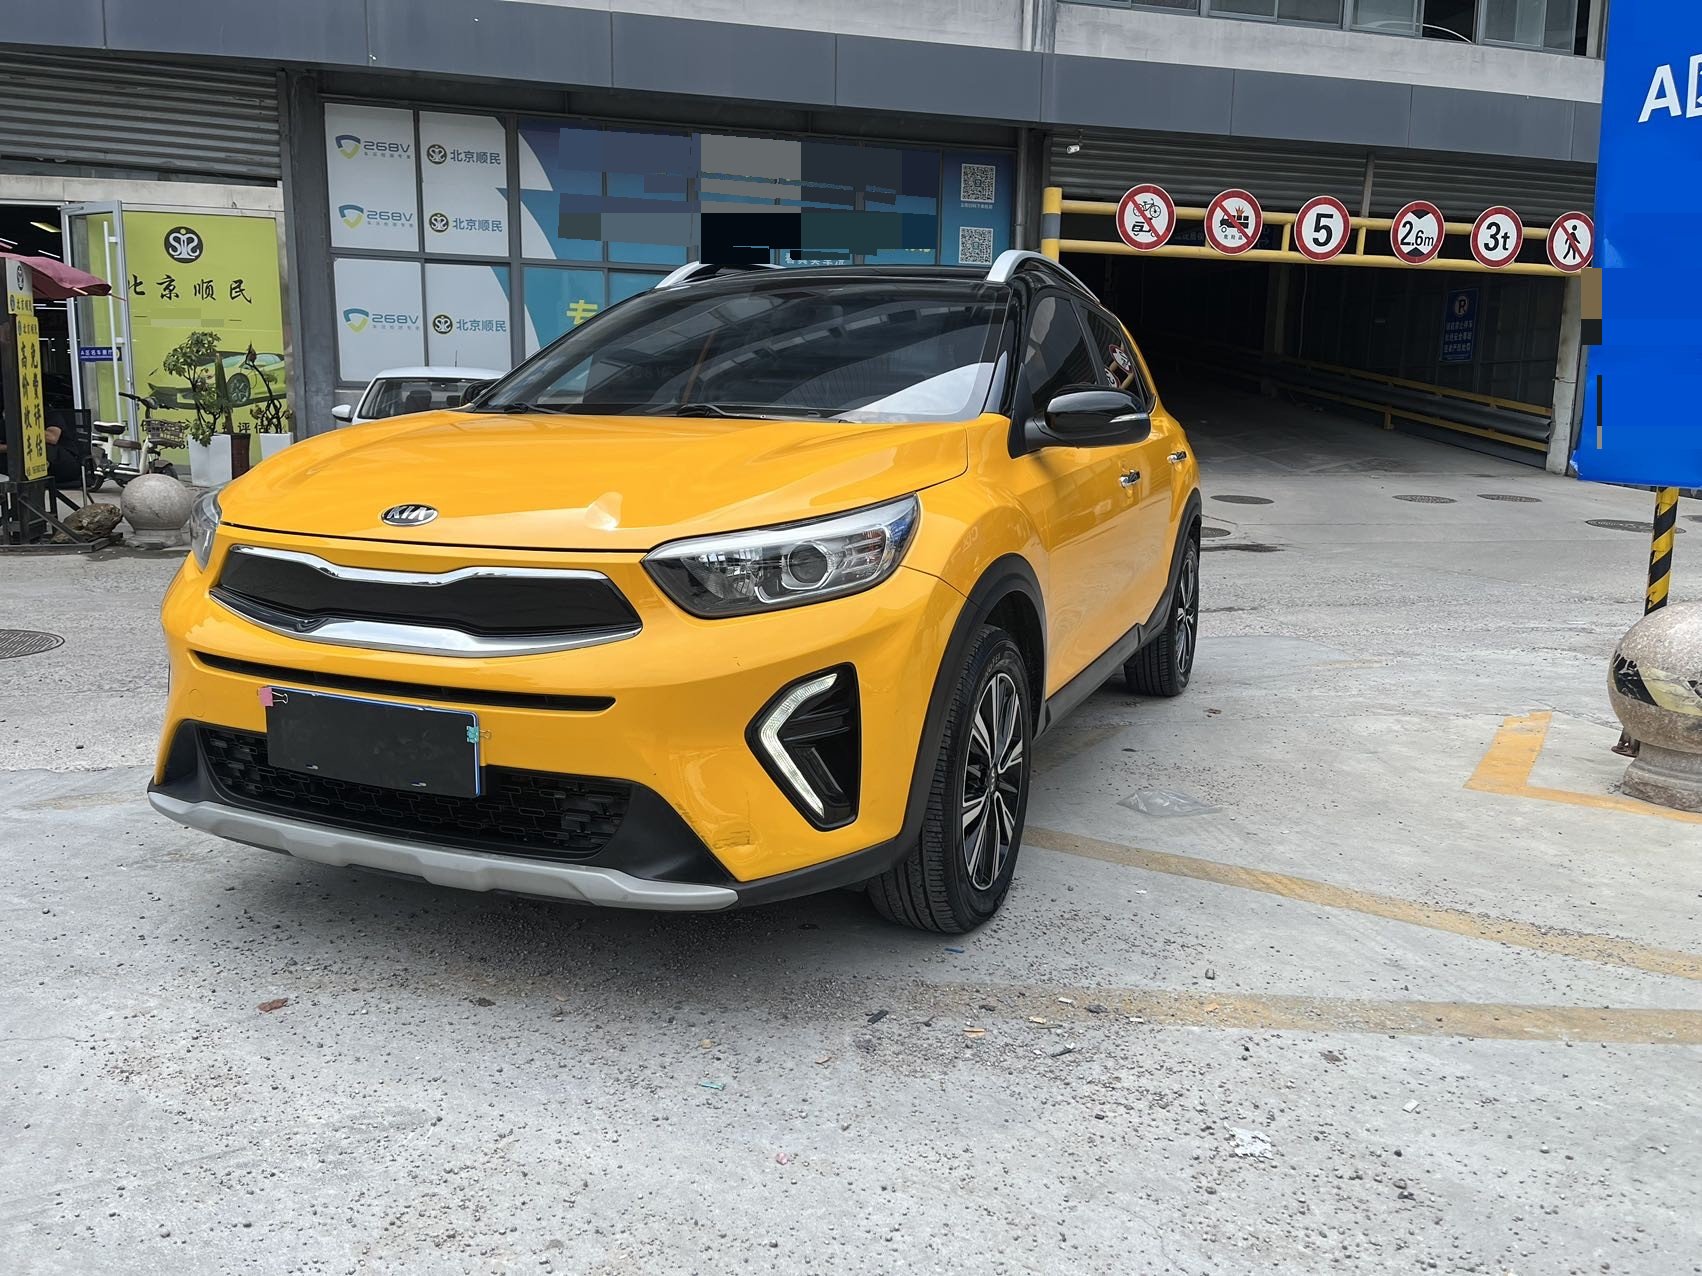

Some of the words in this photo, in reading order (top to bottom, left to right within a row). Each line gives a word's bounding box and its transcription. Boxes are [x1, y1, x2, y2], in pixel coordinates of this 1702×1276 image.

[363, 140, 410, 153] 268V
[450, 149, 501, 165] 北京顺民
[366, 210, 413, 222] 268V
[452, 217, 503, 232] 北京顺民
[1312, 212, 1334, 247] 5
[1400, 220, 1434, 247] 2.6m
[1483, 221, 1511, 252] 3t
[371, 313, 419, 325] 268V
[455, 318, 507, 332] 北京顺民
[385, 504, 430, 522] KIA
